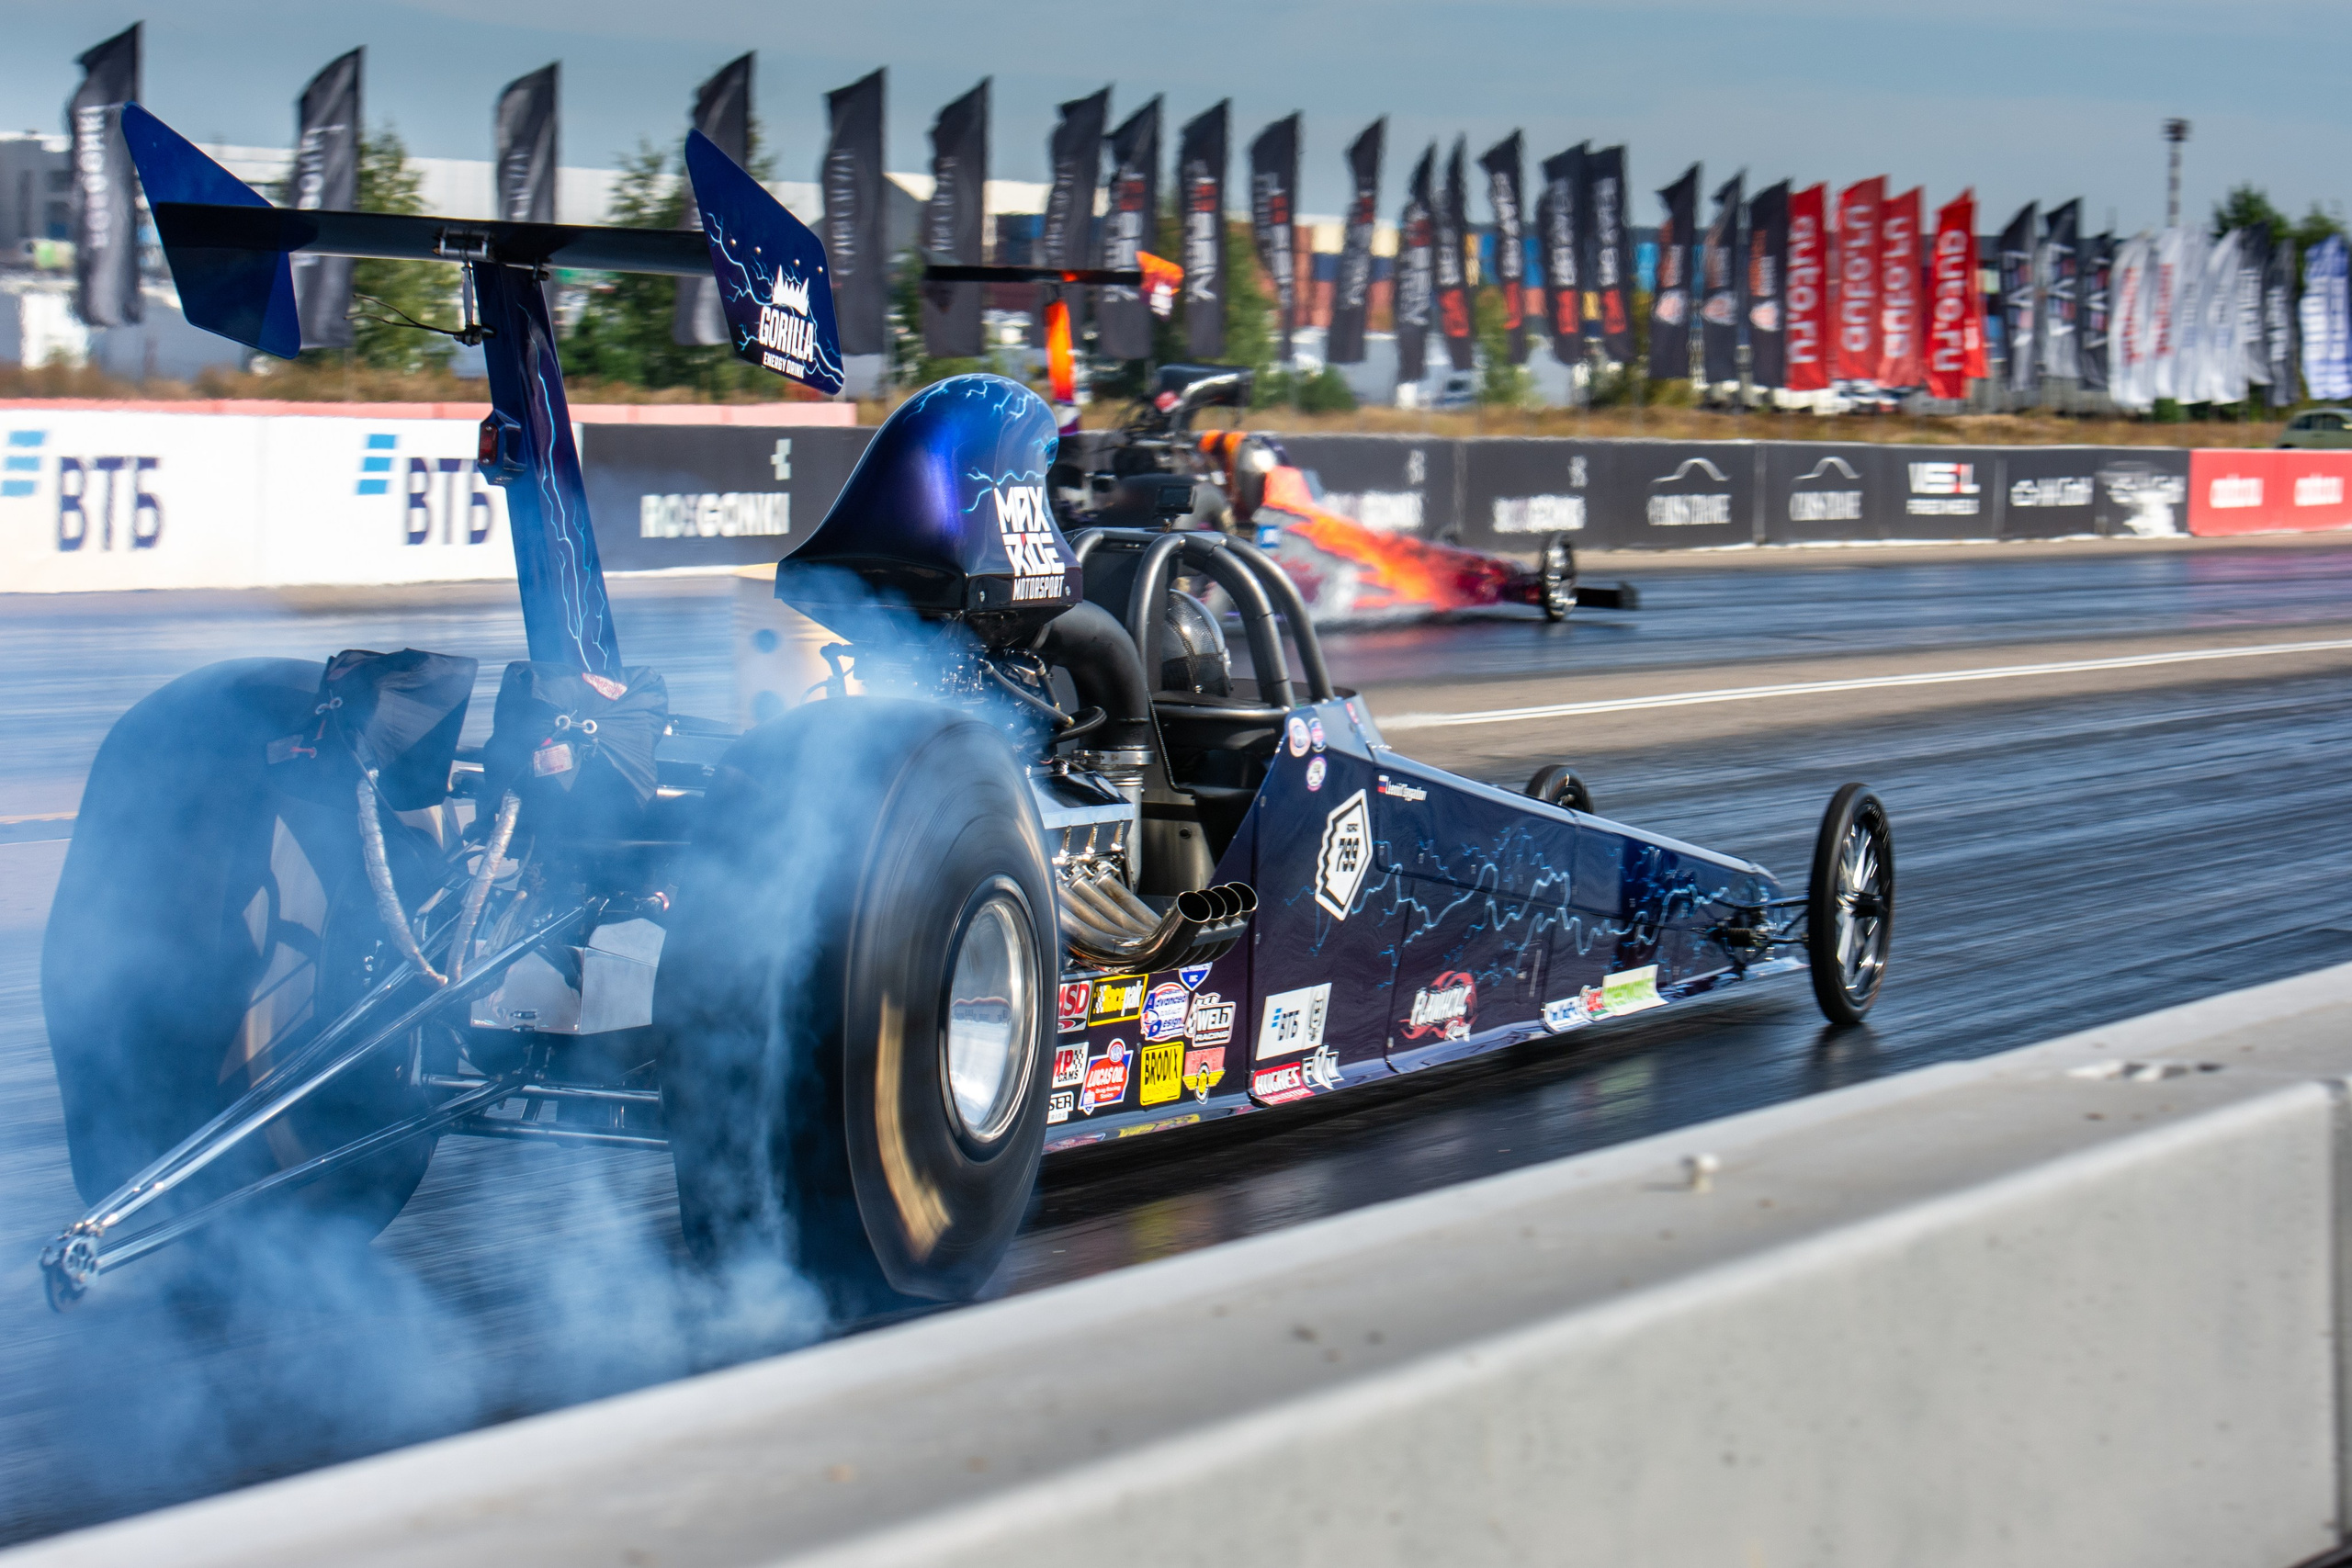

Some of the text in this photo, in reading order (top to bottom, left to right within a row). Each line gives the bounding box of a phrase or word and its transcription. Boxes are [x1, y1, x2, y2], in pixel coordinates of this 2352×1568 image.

[1932, 229, 1968, 372] auto.ru
[758, 305, 814, 363] GORILLA
[763, 351, 805, 379] ENERGY DRINK
[57, 456, 163, 551] ВТБ
[403, 457, 494, 546] ВТБ
[994, 486, 1051, 534] MAX
[1002, 532, 1065, 577] RIDE
[1012, 575, 1065, 601] MOTORSPORT
[1336, 837, 1360, 873] 799
[1195, 1030, 1230, 1042] RACING
[1196, 1007, 1233, 1032] WELD
[1057, 1069, 1079, 1083] CAMS
[1086, 1066, 1125, 1089] LUCAS OIL
[1145, 1048, 1178, 1086] BRODIX
[1255, 1066, 1301, 1096] HUGHES
[1048, 1094, 1072, 1111] SER
